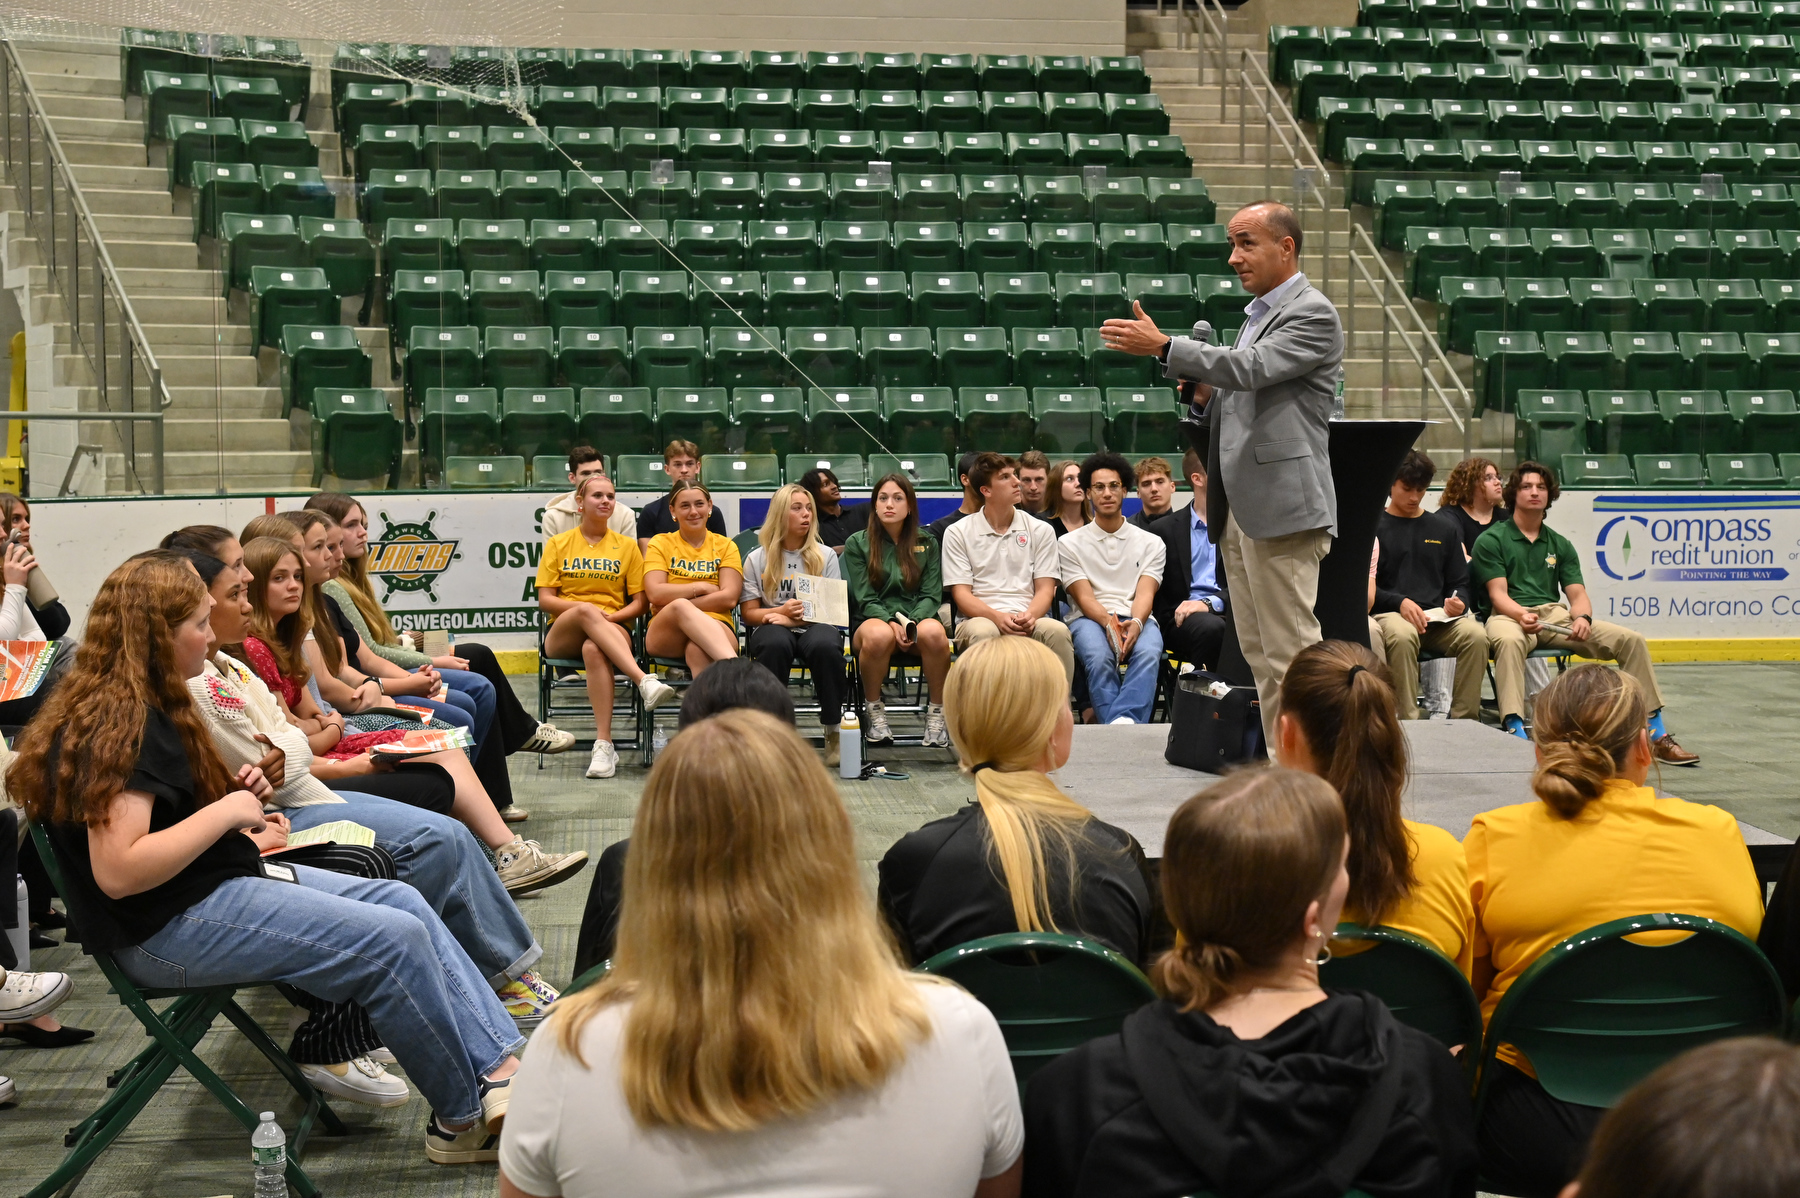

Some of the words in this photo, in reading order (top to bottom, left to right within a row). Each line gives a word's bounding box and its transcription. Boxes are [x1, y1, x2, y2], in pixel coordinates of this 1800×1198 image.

[388, 528, 428, 540] OSWEGO
[1596, 515, 1771, 562] Compass
[368, 543, 455, 572] LAKERS
[488, 542, 542, 568] OSW
[1711, 544, 1774, 565] union
[562, 557, 621, 574] LAKERS
[670, 556, 722, 573] LAKERS
[392, 578, 427, 588] STATE
[588, 572, 619, 582] HOCKEY
[1680, 570, 1727, 580] POINTING
[1731, 571, 1750, 579] THE
[1753, 571, 1772, 579] WAY
[1608, 596, 1660, 616] 150B
[1669, 597, 1763, 616] Marano
[391, 611, 540, 632] OSWEGOLAKERS.C
